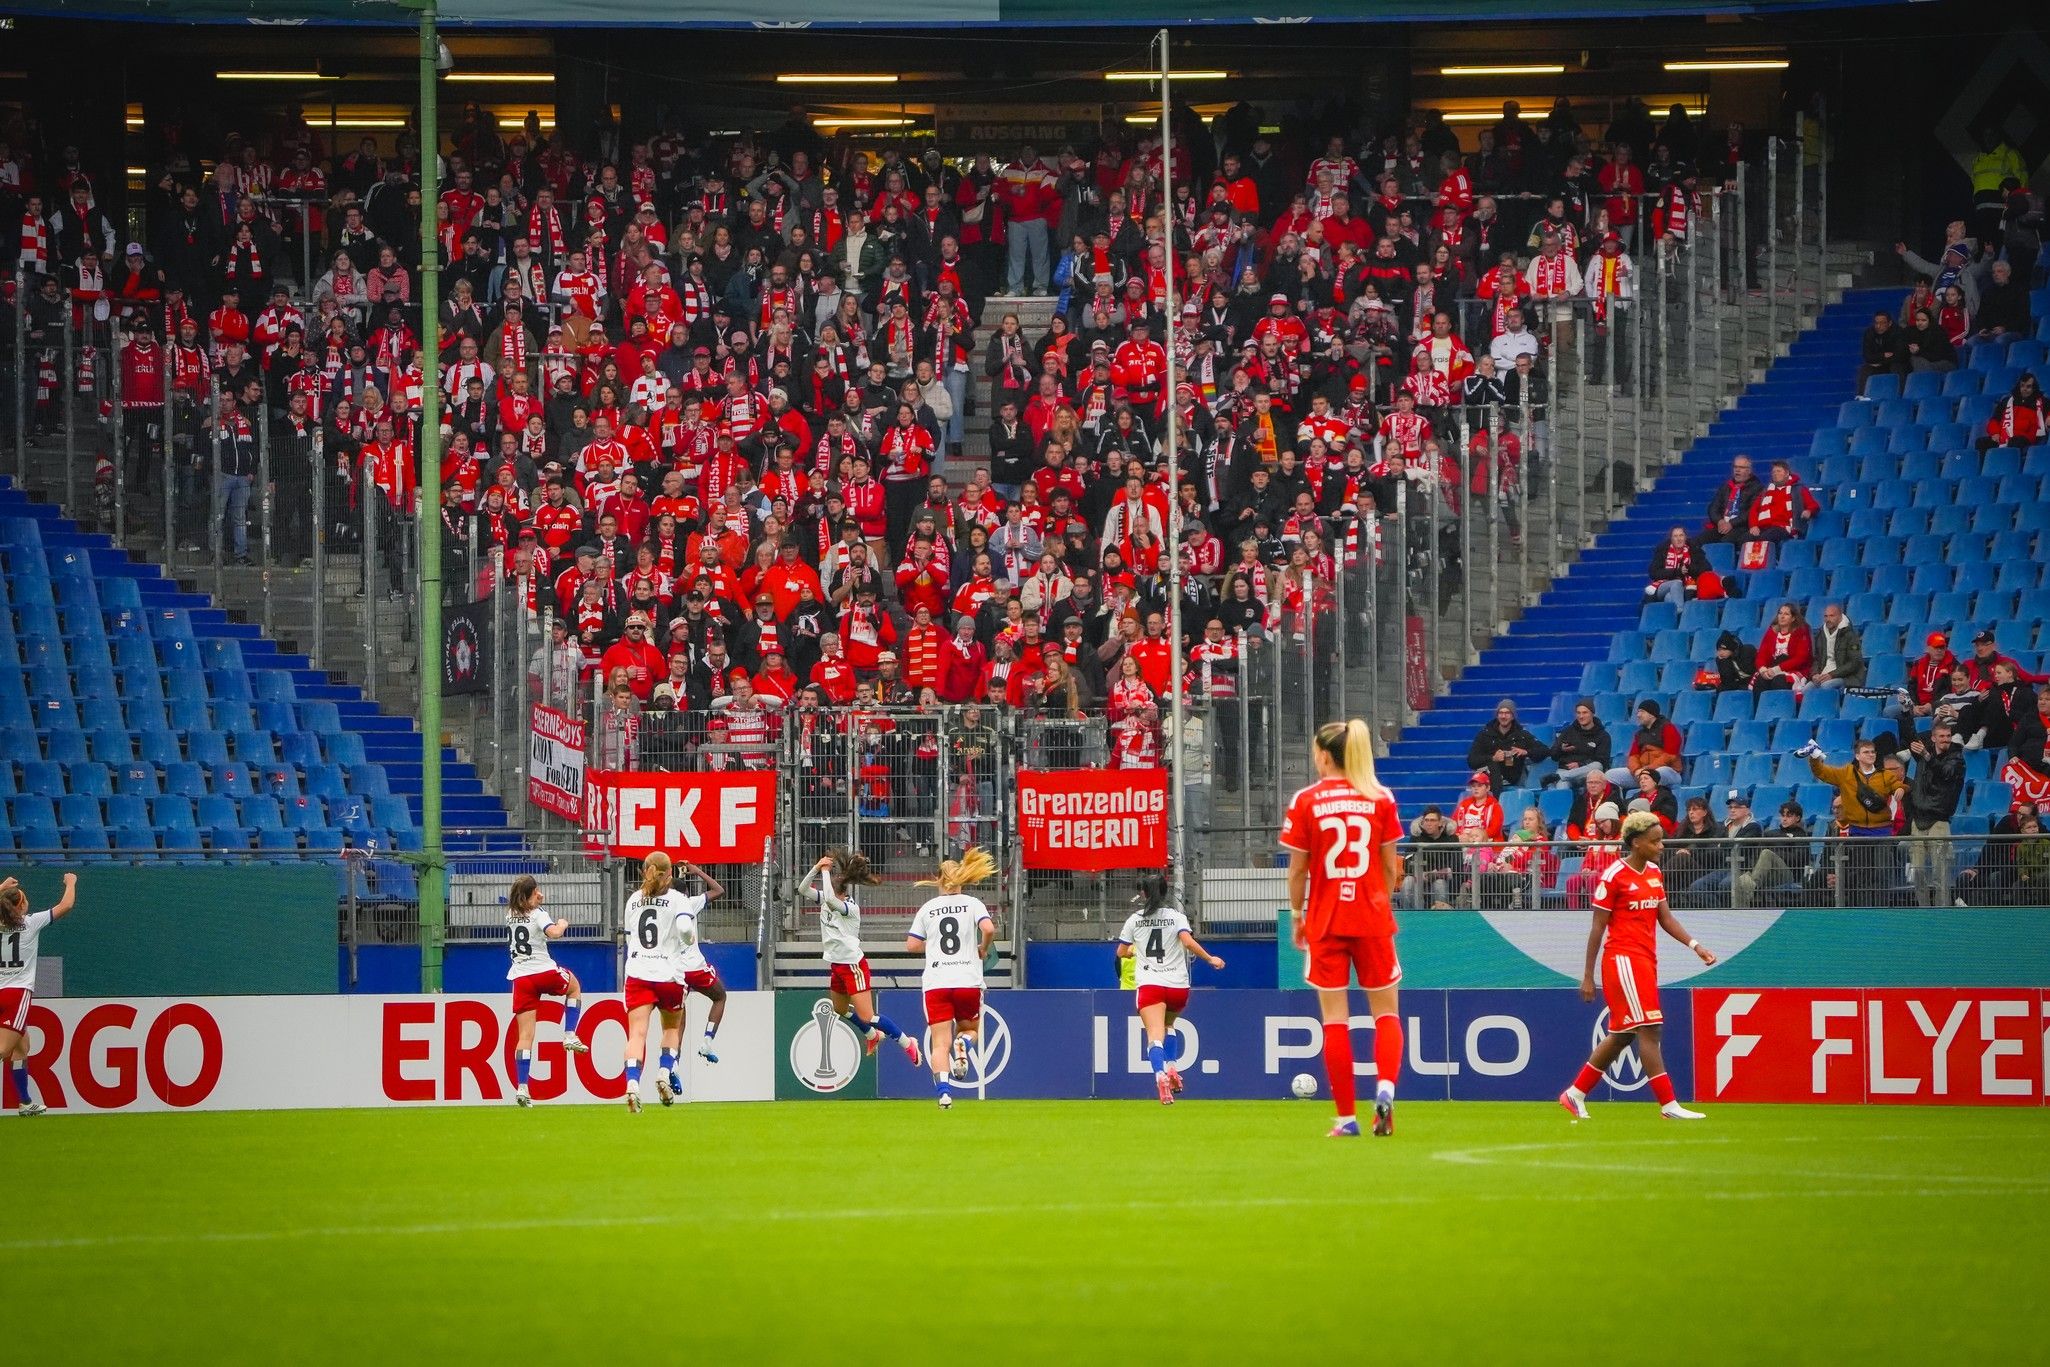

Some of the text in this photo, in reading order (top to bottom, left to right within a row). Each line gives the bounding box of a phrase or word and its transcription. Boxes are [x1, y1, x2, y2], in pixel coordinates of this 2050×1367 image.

[720, 786, 757, 847] F
[1022, 786, 1164, 815] Grenzenlos
[1312, 800, 1376, 818] BAUEREISEN
[1048, 817, 1139, 850] EISERN
[1319, 814, 1372, 880] 23
[638, 908, 659, 950] 6
[929, 905, 969, 919] STOLDT
[939, 916, 961, 956] 8
[1145, 929, 1166, 964] 4
[382, 999, 646, 1101] ERGO
[1264, 1015, 1531, 1076] POLO
[1811, 1000, 2050, 1096] FLYE
